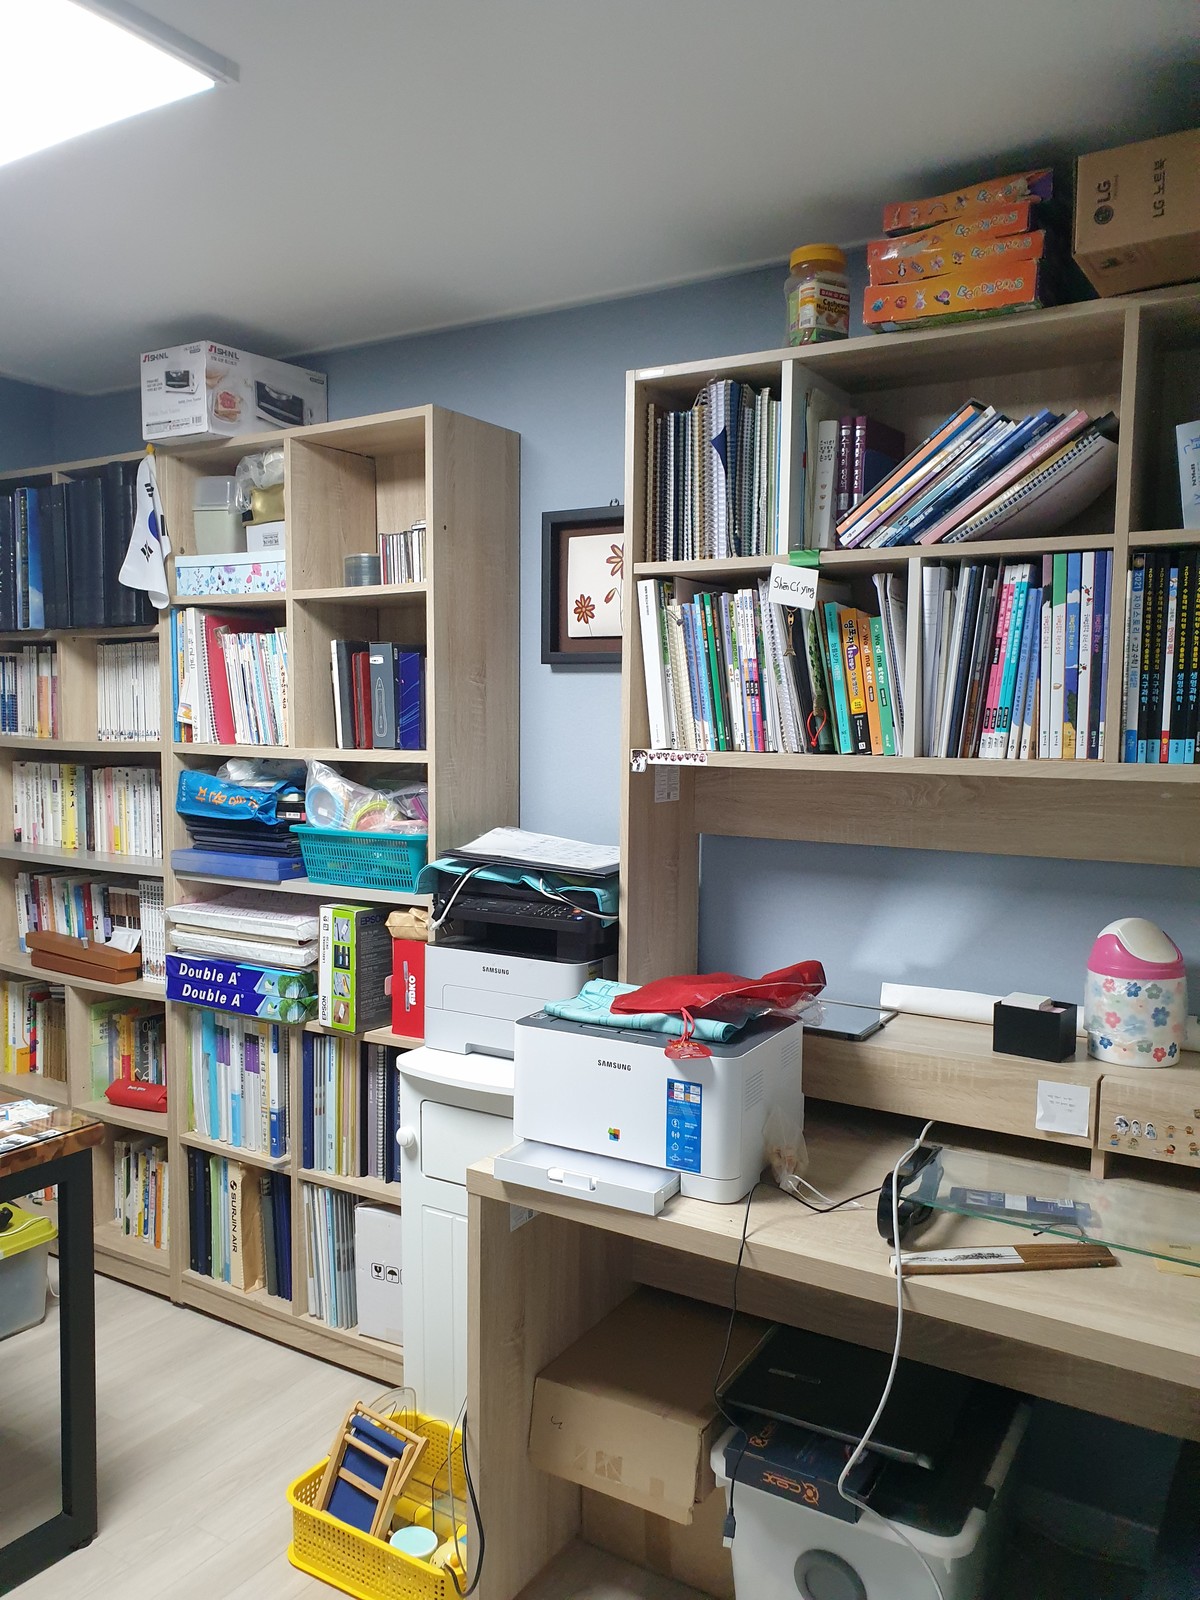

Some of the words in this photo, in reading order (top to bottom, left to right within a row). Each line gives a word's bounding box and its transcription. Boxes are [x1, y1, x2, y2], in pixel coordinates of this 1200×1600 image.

[1097, 180, 1111, 203] LG
[1153, 200, 1165, 218] LG
[1134, 572, 1142, 589] 2021
[1132, 595, 1142, 634] 자이스토리
[862, 634, 871, 654] Word
[874, 634, 883, 654] Word
[864, 655, 873, 683] master
[876, 655, 885, 684] master
[1141, 673, 1149, 704] 지구과학
[1176, 672, 1184, 703] 생명과학
[1189, 672, 1198, 703] 생명과학
[179, 963, 224, 983] Double
[482, 966, 510, 976] SAMSUNG
[182, 984, 227, 1004] Double
[597, 1059, 632, 1072] SAMSUNG
